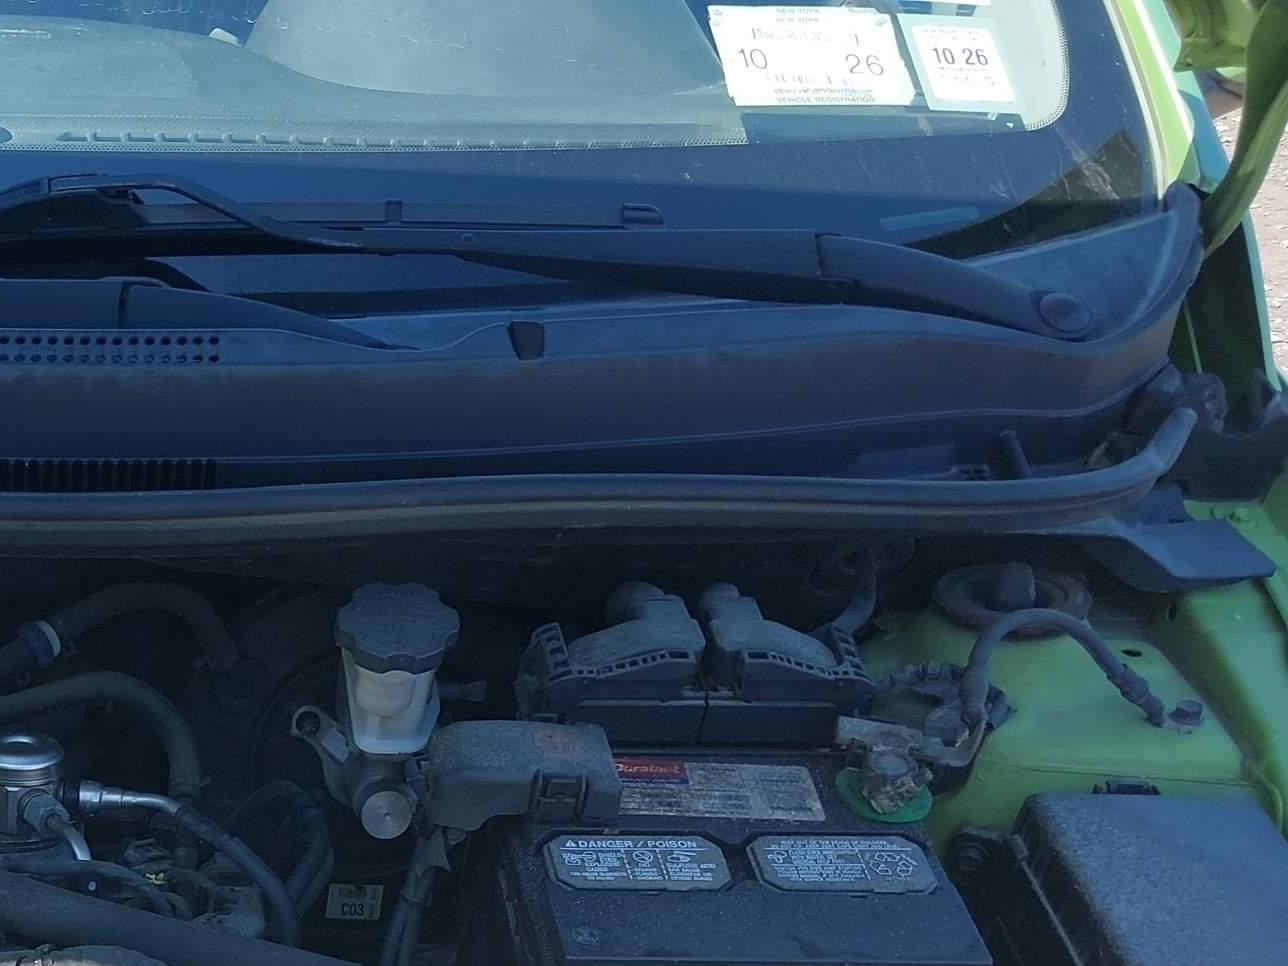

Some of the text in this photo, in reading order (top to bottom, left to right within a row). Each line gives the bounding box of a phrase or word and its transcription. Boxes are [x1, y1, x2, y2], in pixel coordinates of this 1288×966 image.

[737, 48, 885, 76] 10 26
[933, 47, 989, 66] 10 26
[578, 840, 632, 848] DANGER
[647, 840, 697, 848] POISON
